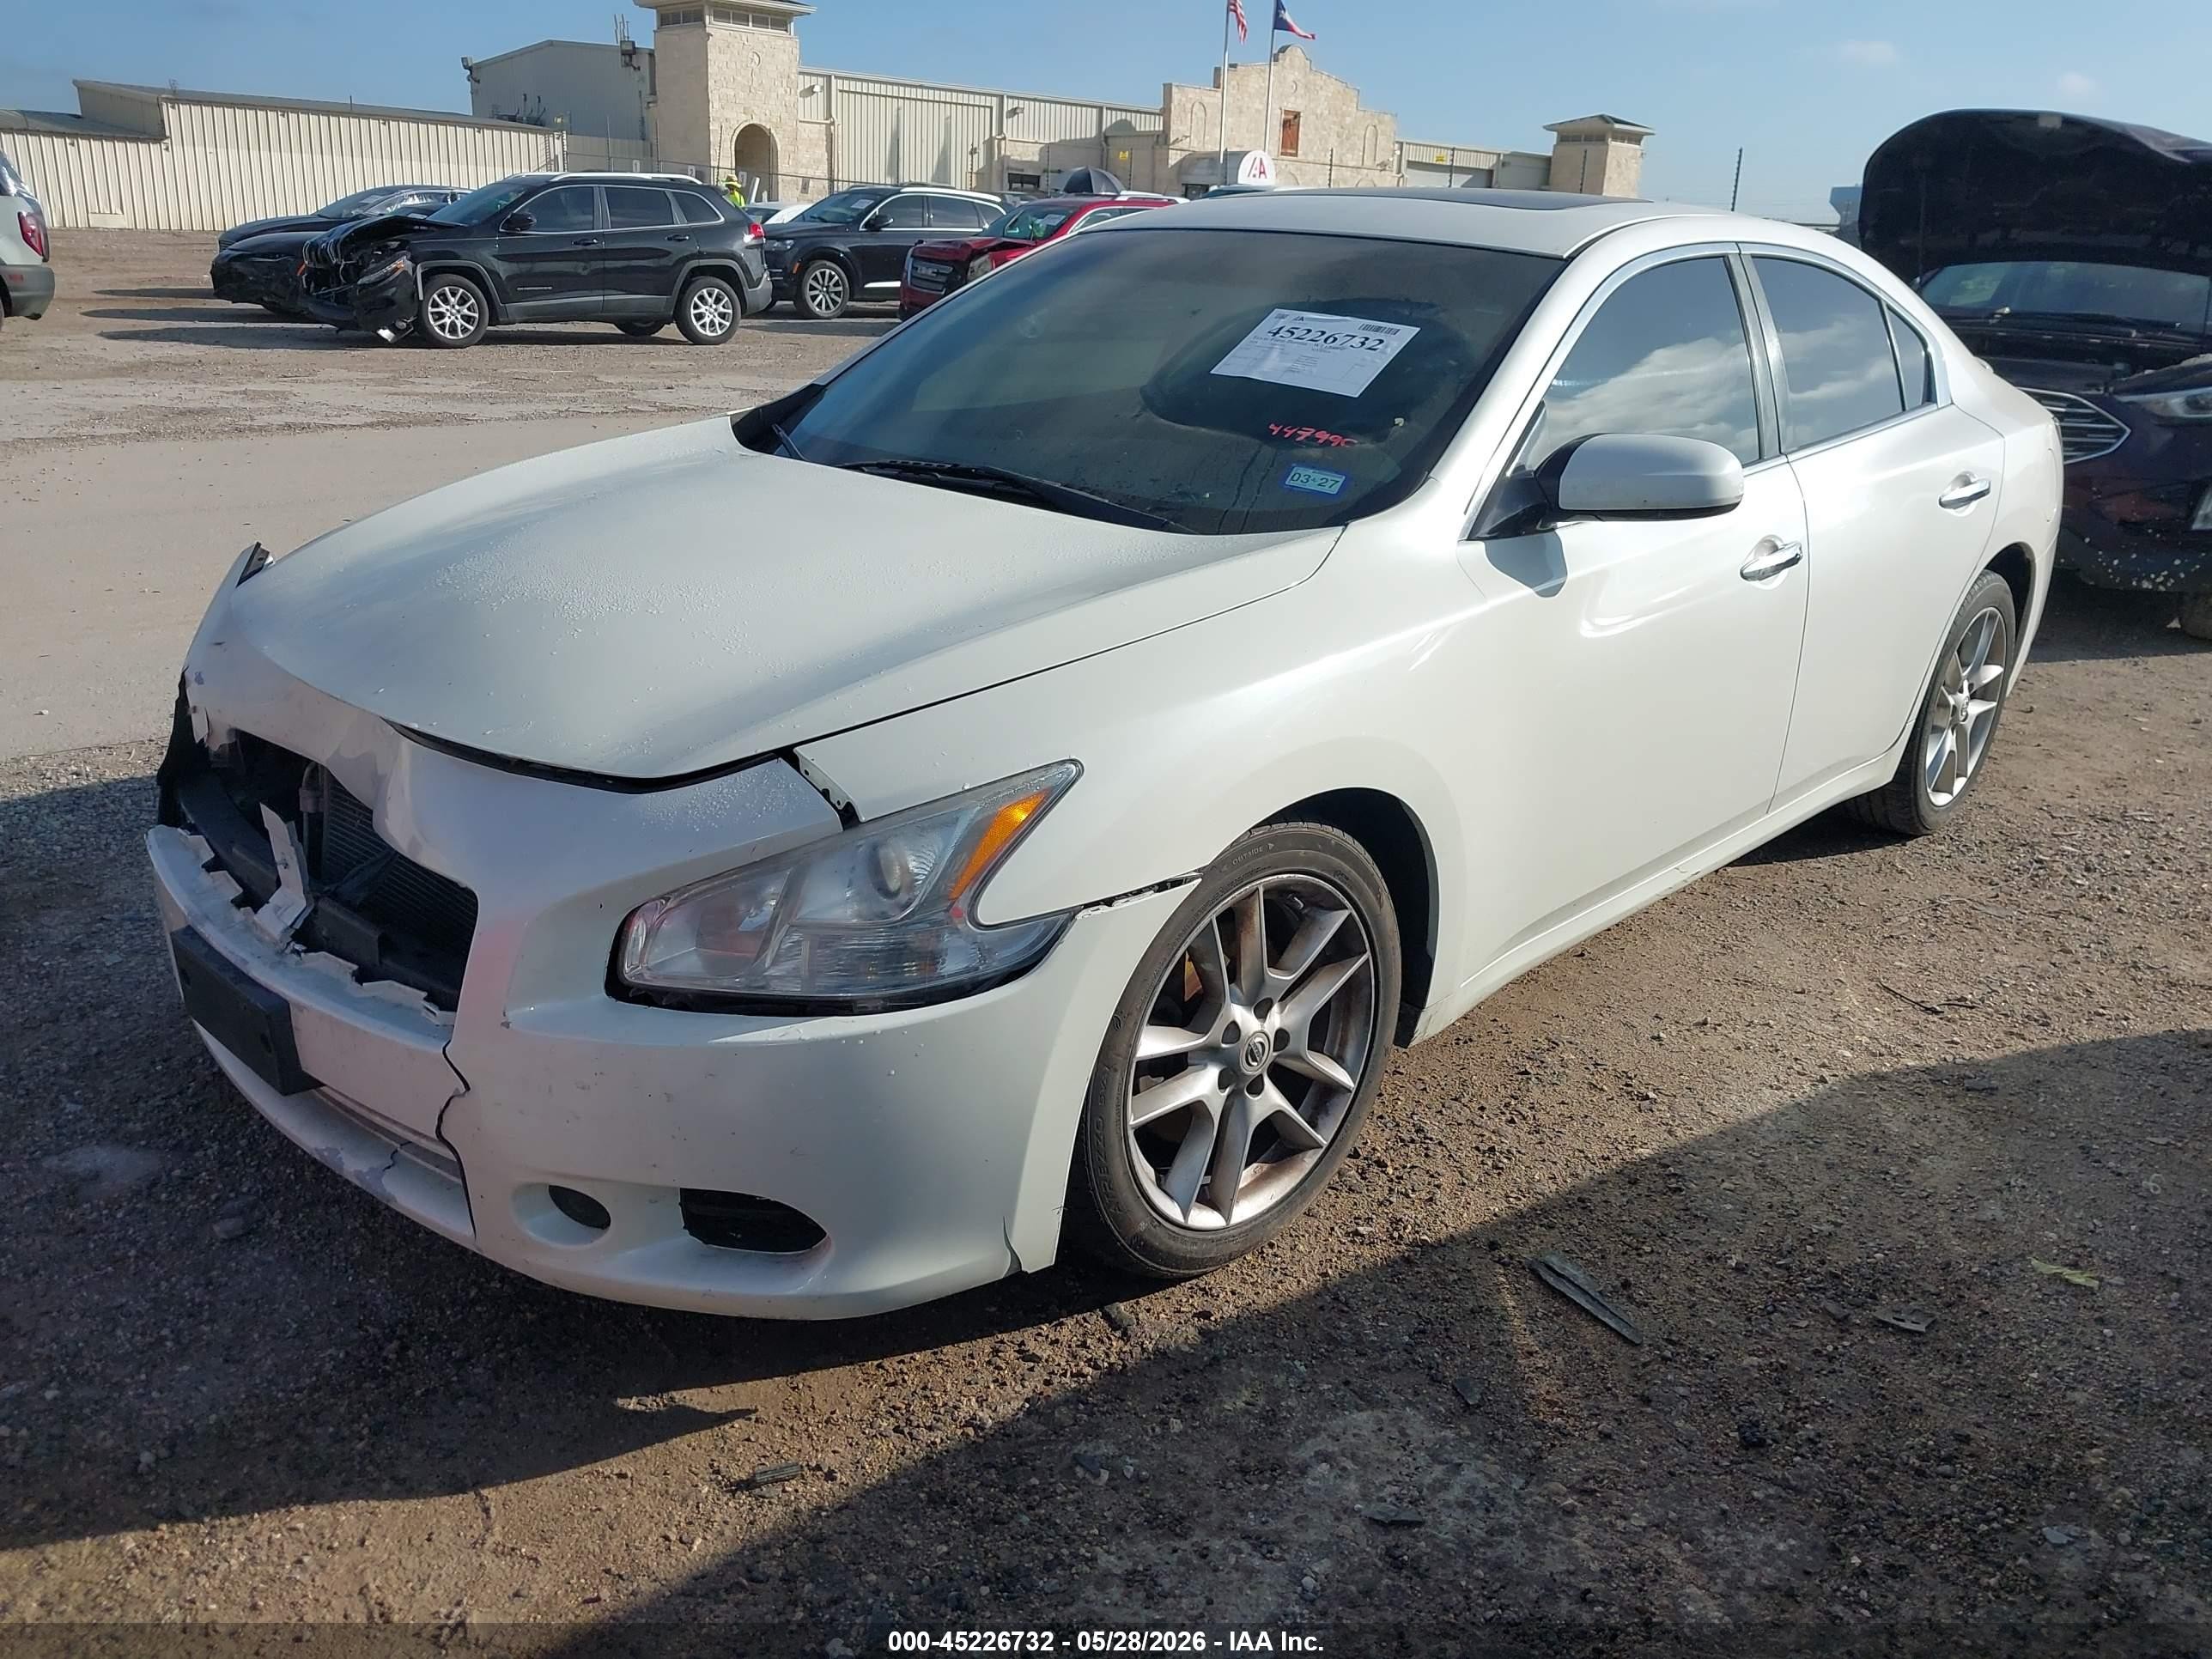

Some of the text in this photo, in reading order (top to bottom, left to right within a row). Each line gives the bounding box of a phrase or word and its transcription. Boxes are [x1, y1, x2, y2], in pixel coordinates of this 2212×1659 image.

[1267, 324, 1385, 351] 45226732
[1291, 472, 1311, 483] 03
[1317, 477, 1340, 489] 27
